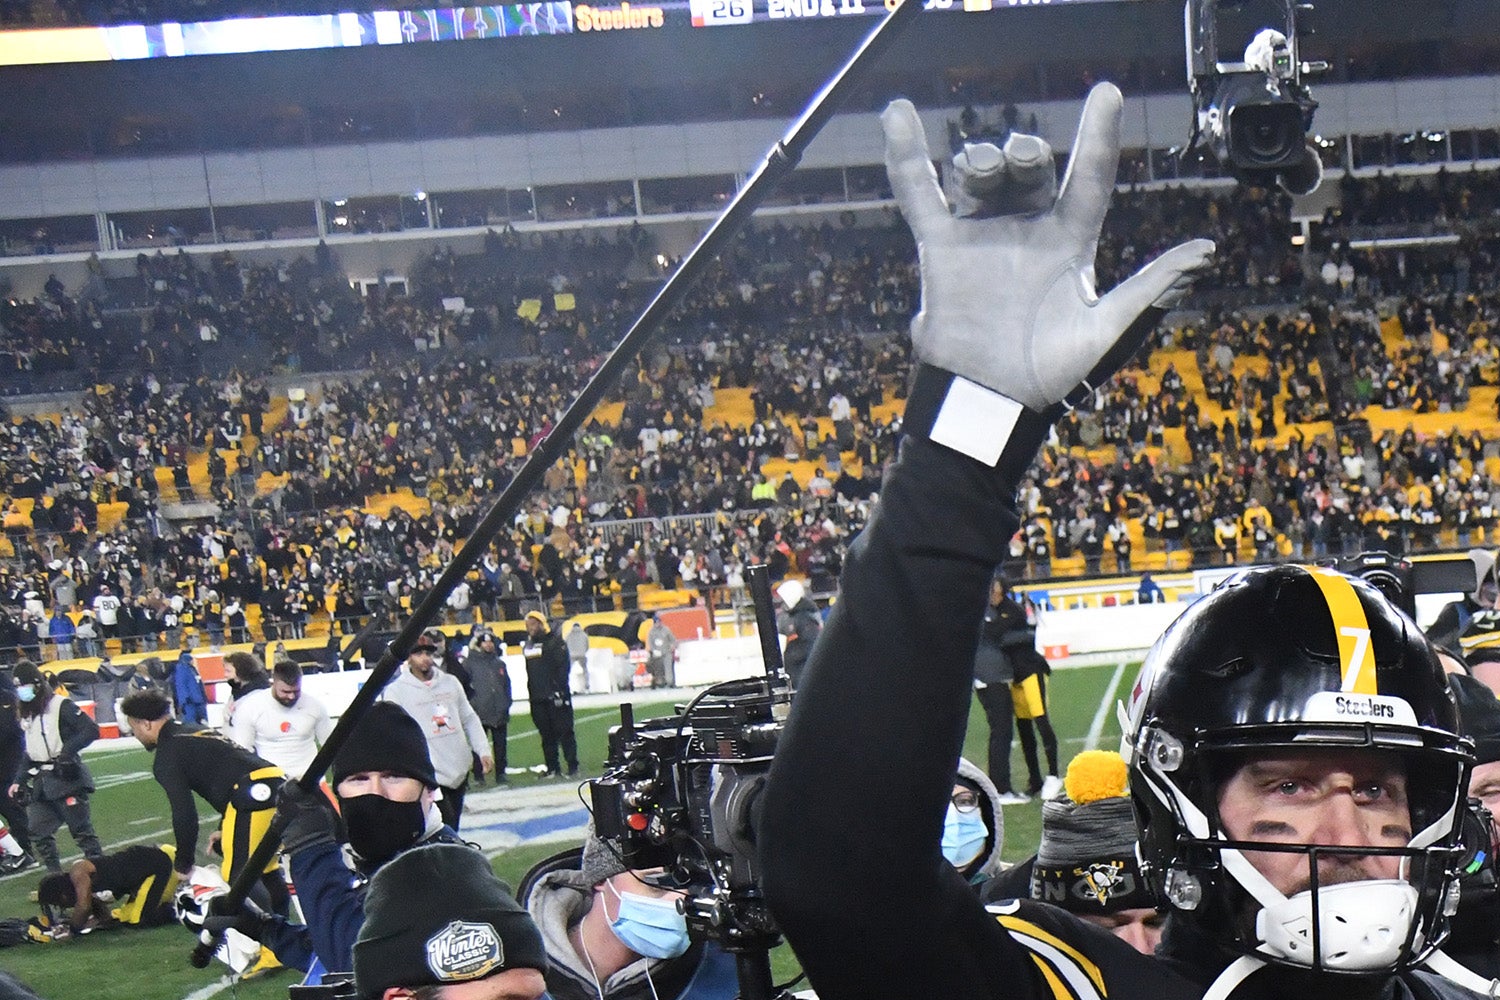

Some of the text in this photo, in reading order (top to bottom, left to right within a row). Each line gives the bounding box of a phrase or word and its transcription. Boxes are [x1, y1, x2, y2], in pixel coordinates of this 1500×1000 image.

[575, 2, 664, 32] Steelers
[1340, 626, 1371, 694] 7
[1335, 696, 1394, 718] Steelers
[430, 930, 495, 969] Winter
[443, 945, 491, 967] CLASSIC
